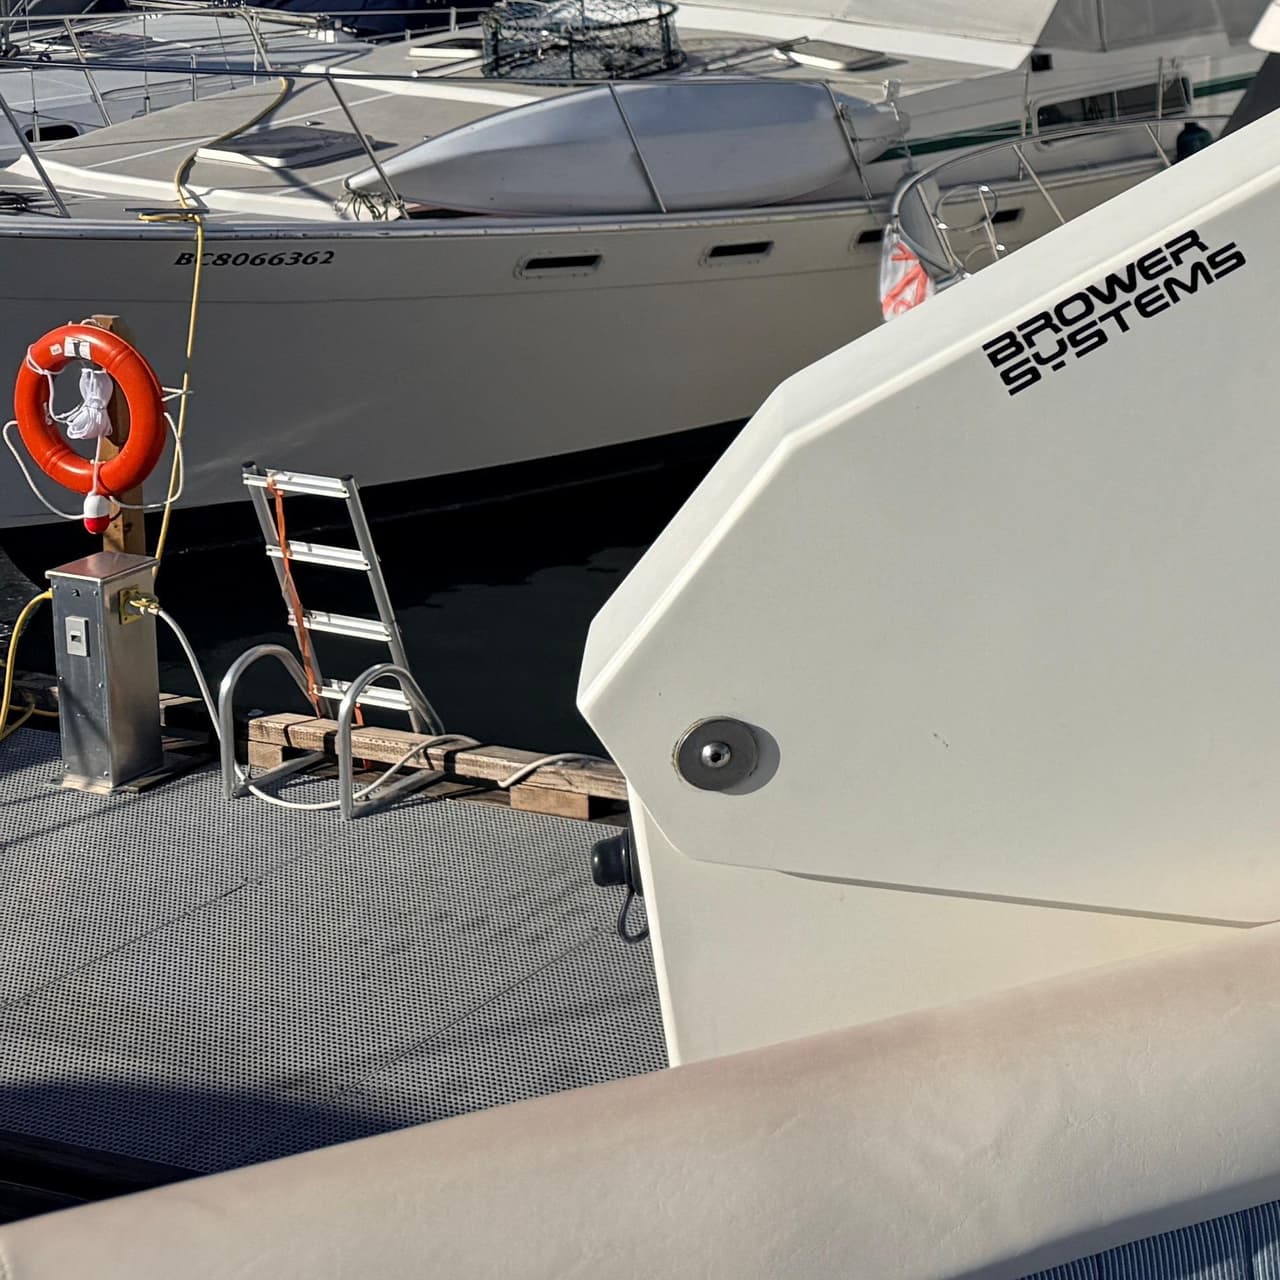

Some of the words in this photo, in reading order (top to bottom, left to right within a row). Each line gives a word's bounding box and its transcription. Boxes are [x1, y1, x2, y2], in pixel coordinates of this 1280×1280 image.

[174, 251, 335, 266] BC8066362
[982, 229, 1209, 368] BROWER
[1000, 242, 1246, 396] SYSTEMS
